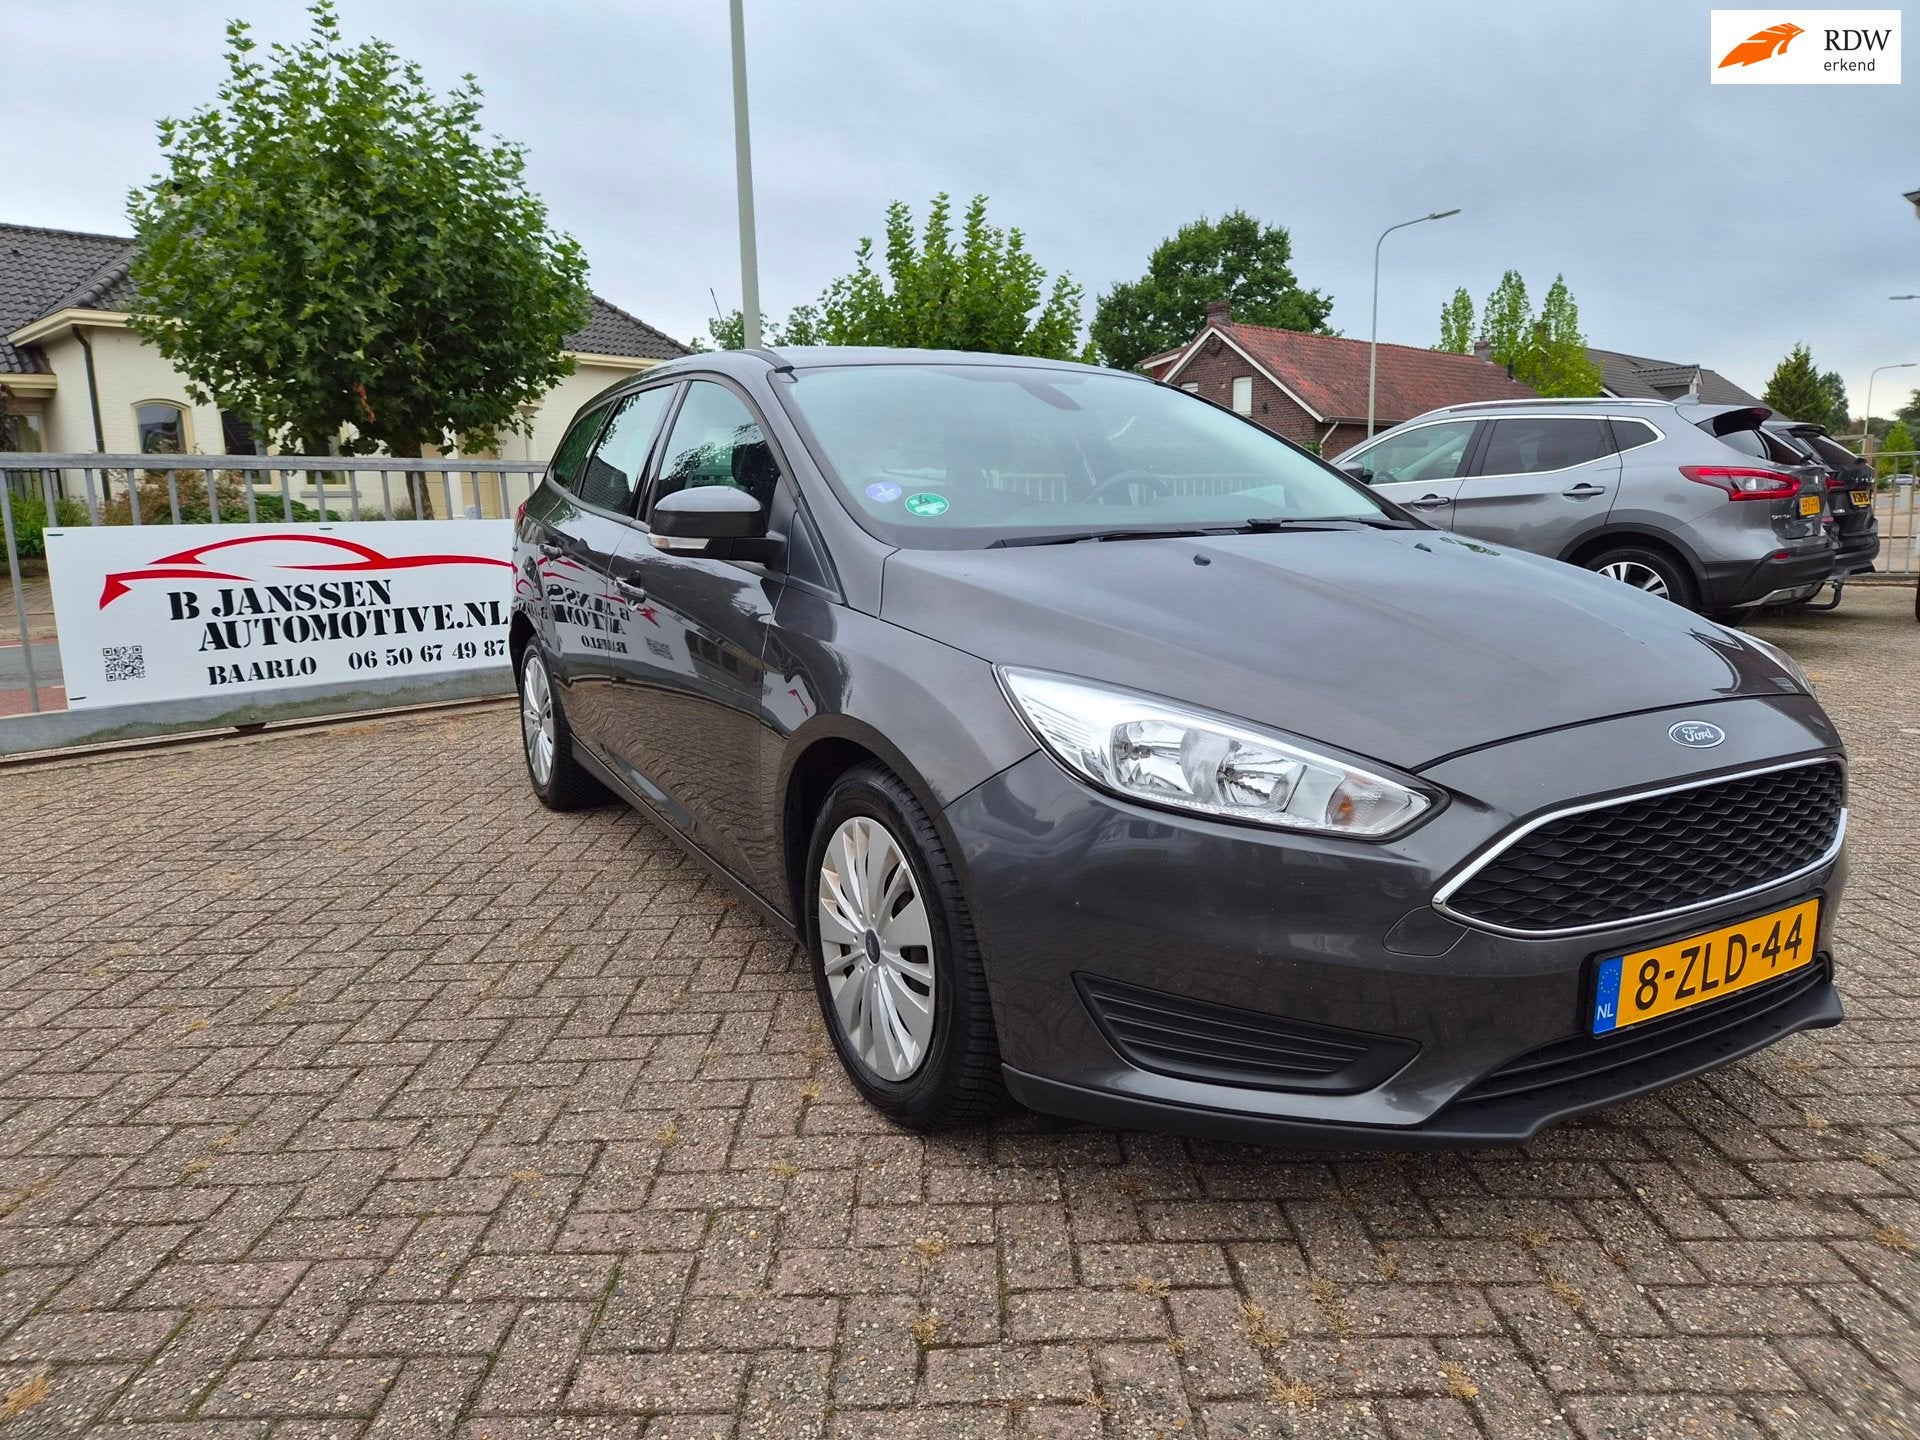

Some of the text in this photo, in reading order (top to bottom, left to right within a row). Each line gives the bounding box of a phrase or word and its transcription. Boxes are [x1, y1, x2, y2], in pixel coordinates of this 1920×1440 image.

[166, 579, 391, 621] B JANSSEN
[198, 600, 508, 652] AUTOMOTIVE.NL
[207, 639, 506, 686] BAARLO 06 50 67 49 87
[1681, 726, 1715, 742] Ford
[1635, 913, 1803, 1011] 8-ZLD-44
[1596, 1003, 1614, 1021] NL
